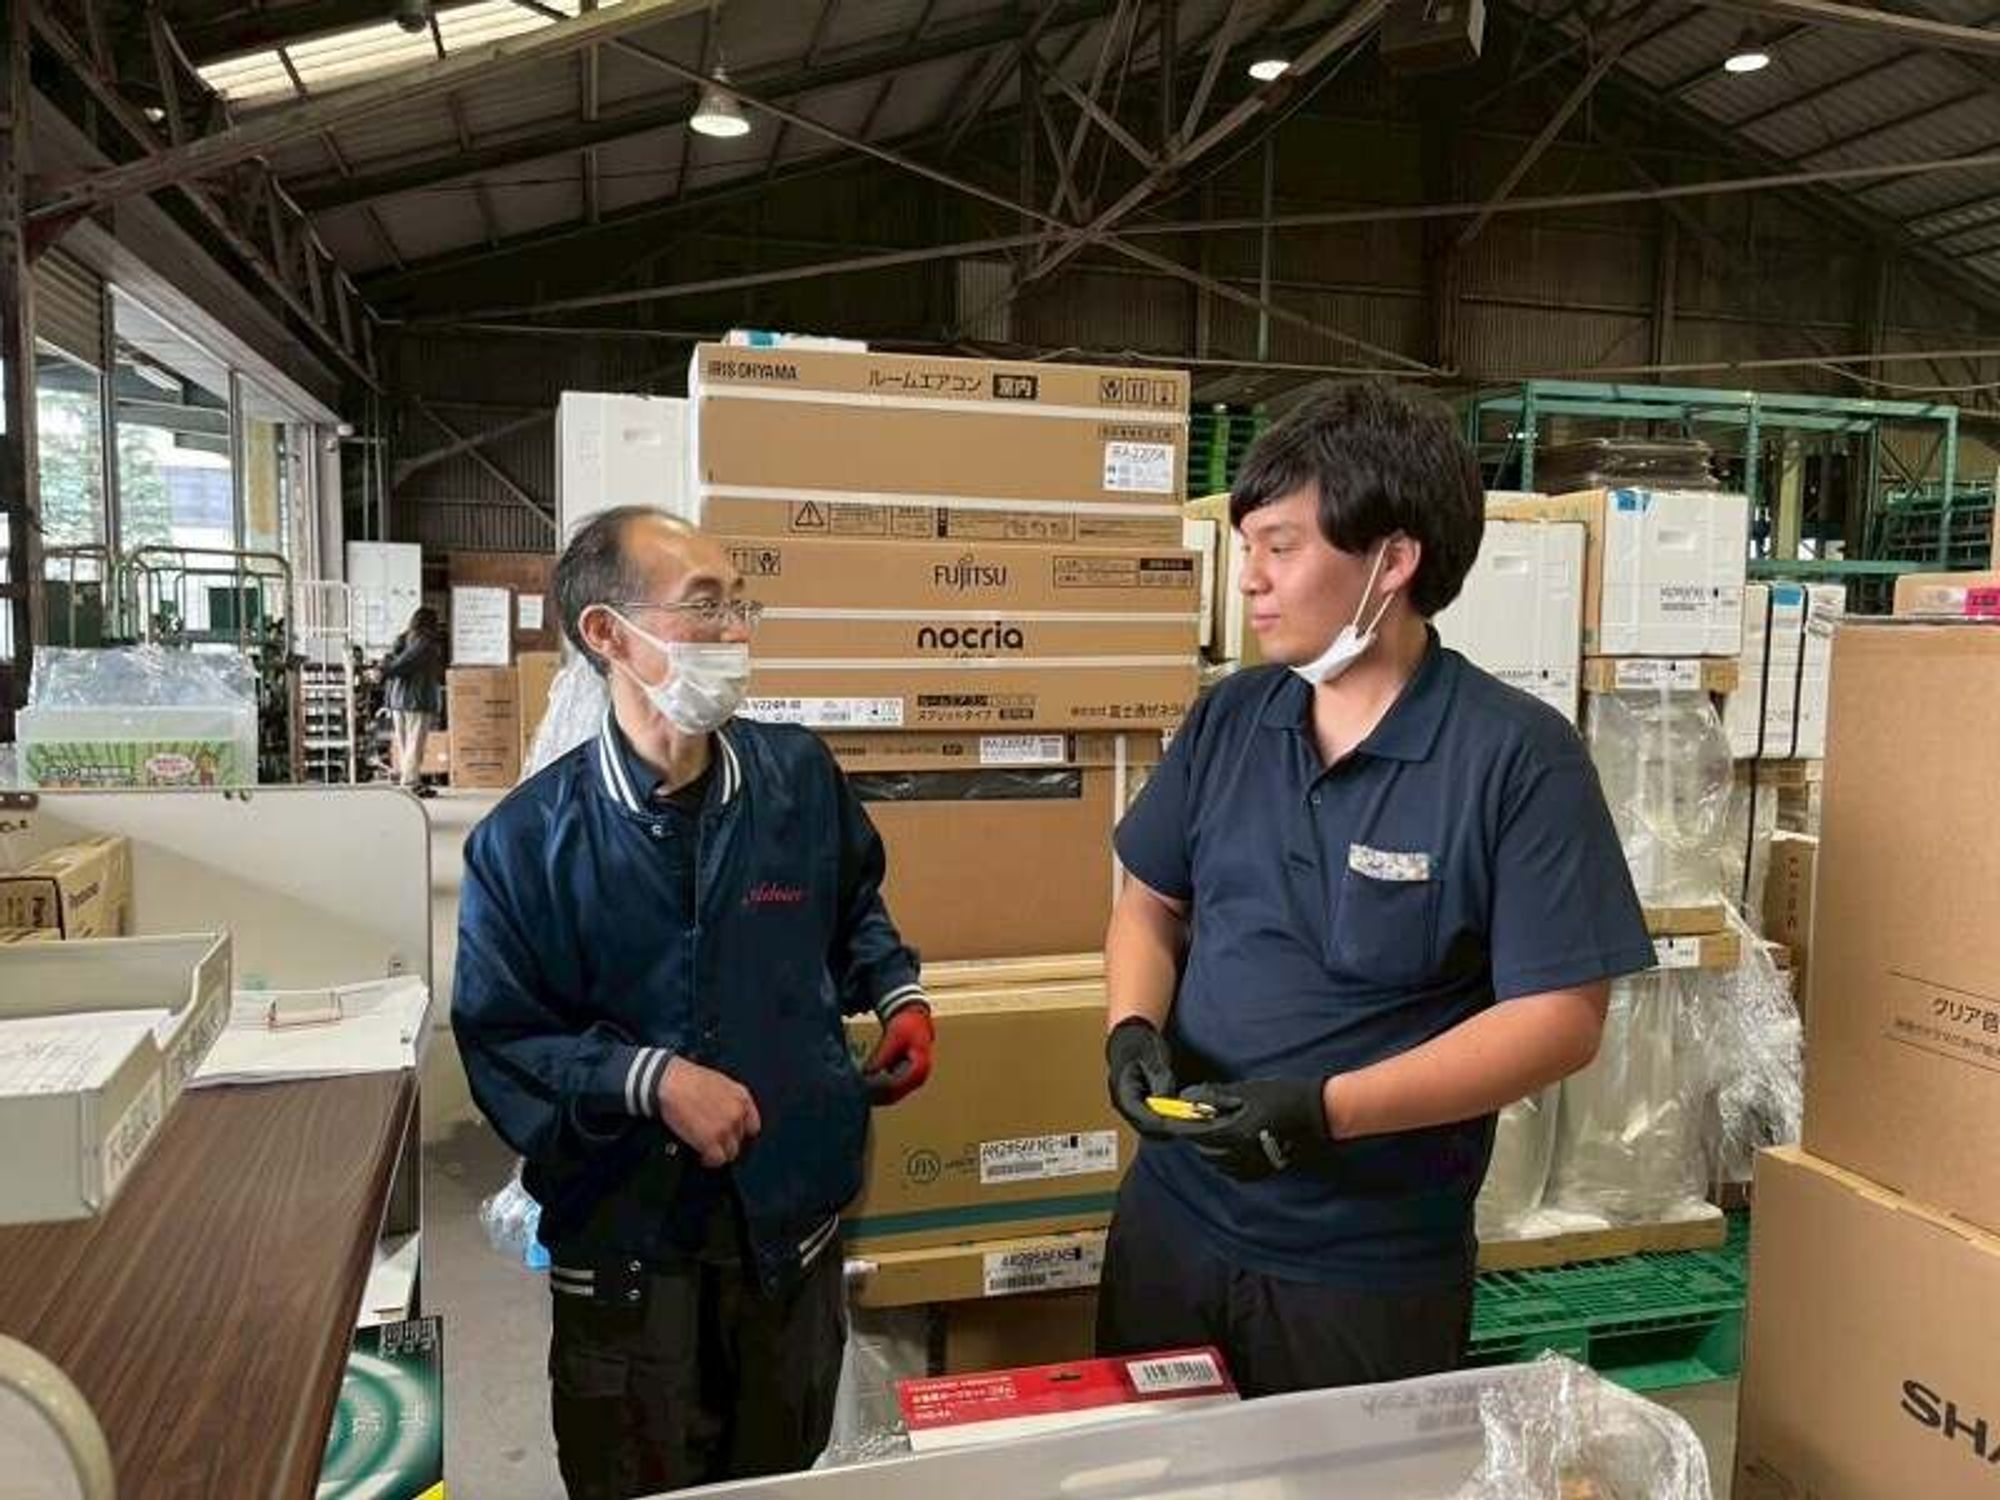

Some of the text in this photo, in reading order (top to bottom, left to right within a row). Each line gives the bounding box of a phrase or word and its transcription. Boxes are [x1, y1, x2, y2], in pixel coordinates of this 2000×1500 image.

[738, 361, 799, 379] OHYAMA
[869, 369, 981, 391] ルームエアコン
[934, 563, 1007, 591] FUJITSU
[917, 621, 1024, 649] nocria
[1901, 1379, 1999, 1464] SH
